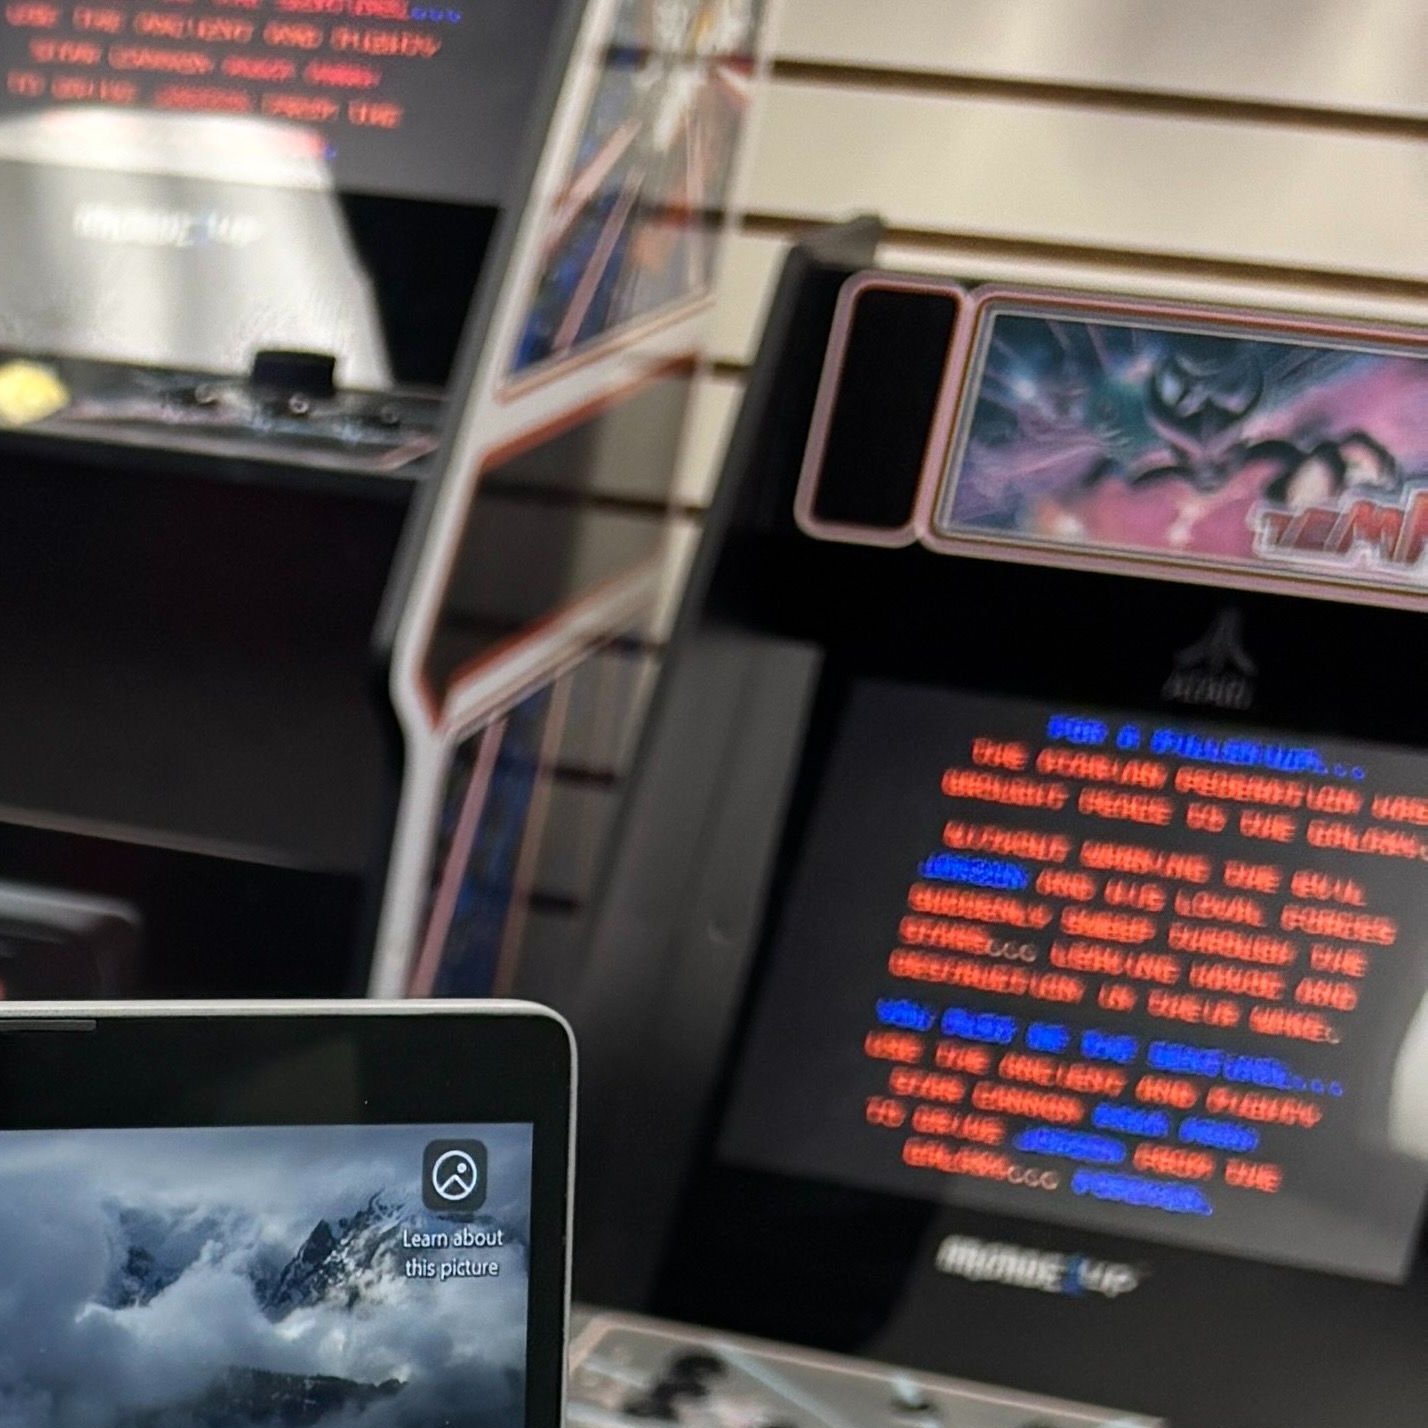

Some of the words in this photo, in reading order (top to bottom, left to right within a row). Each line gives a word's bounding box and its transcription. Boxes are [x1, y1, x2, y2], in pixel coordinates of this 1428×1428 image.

[403, 1230, 447, 1248] Learn
[453, 1228, 502, 1246] about
[406, 1259, 435, 1276] this
[441, 1259, 498, 1280] picture
